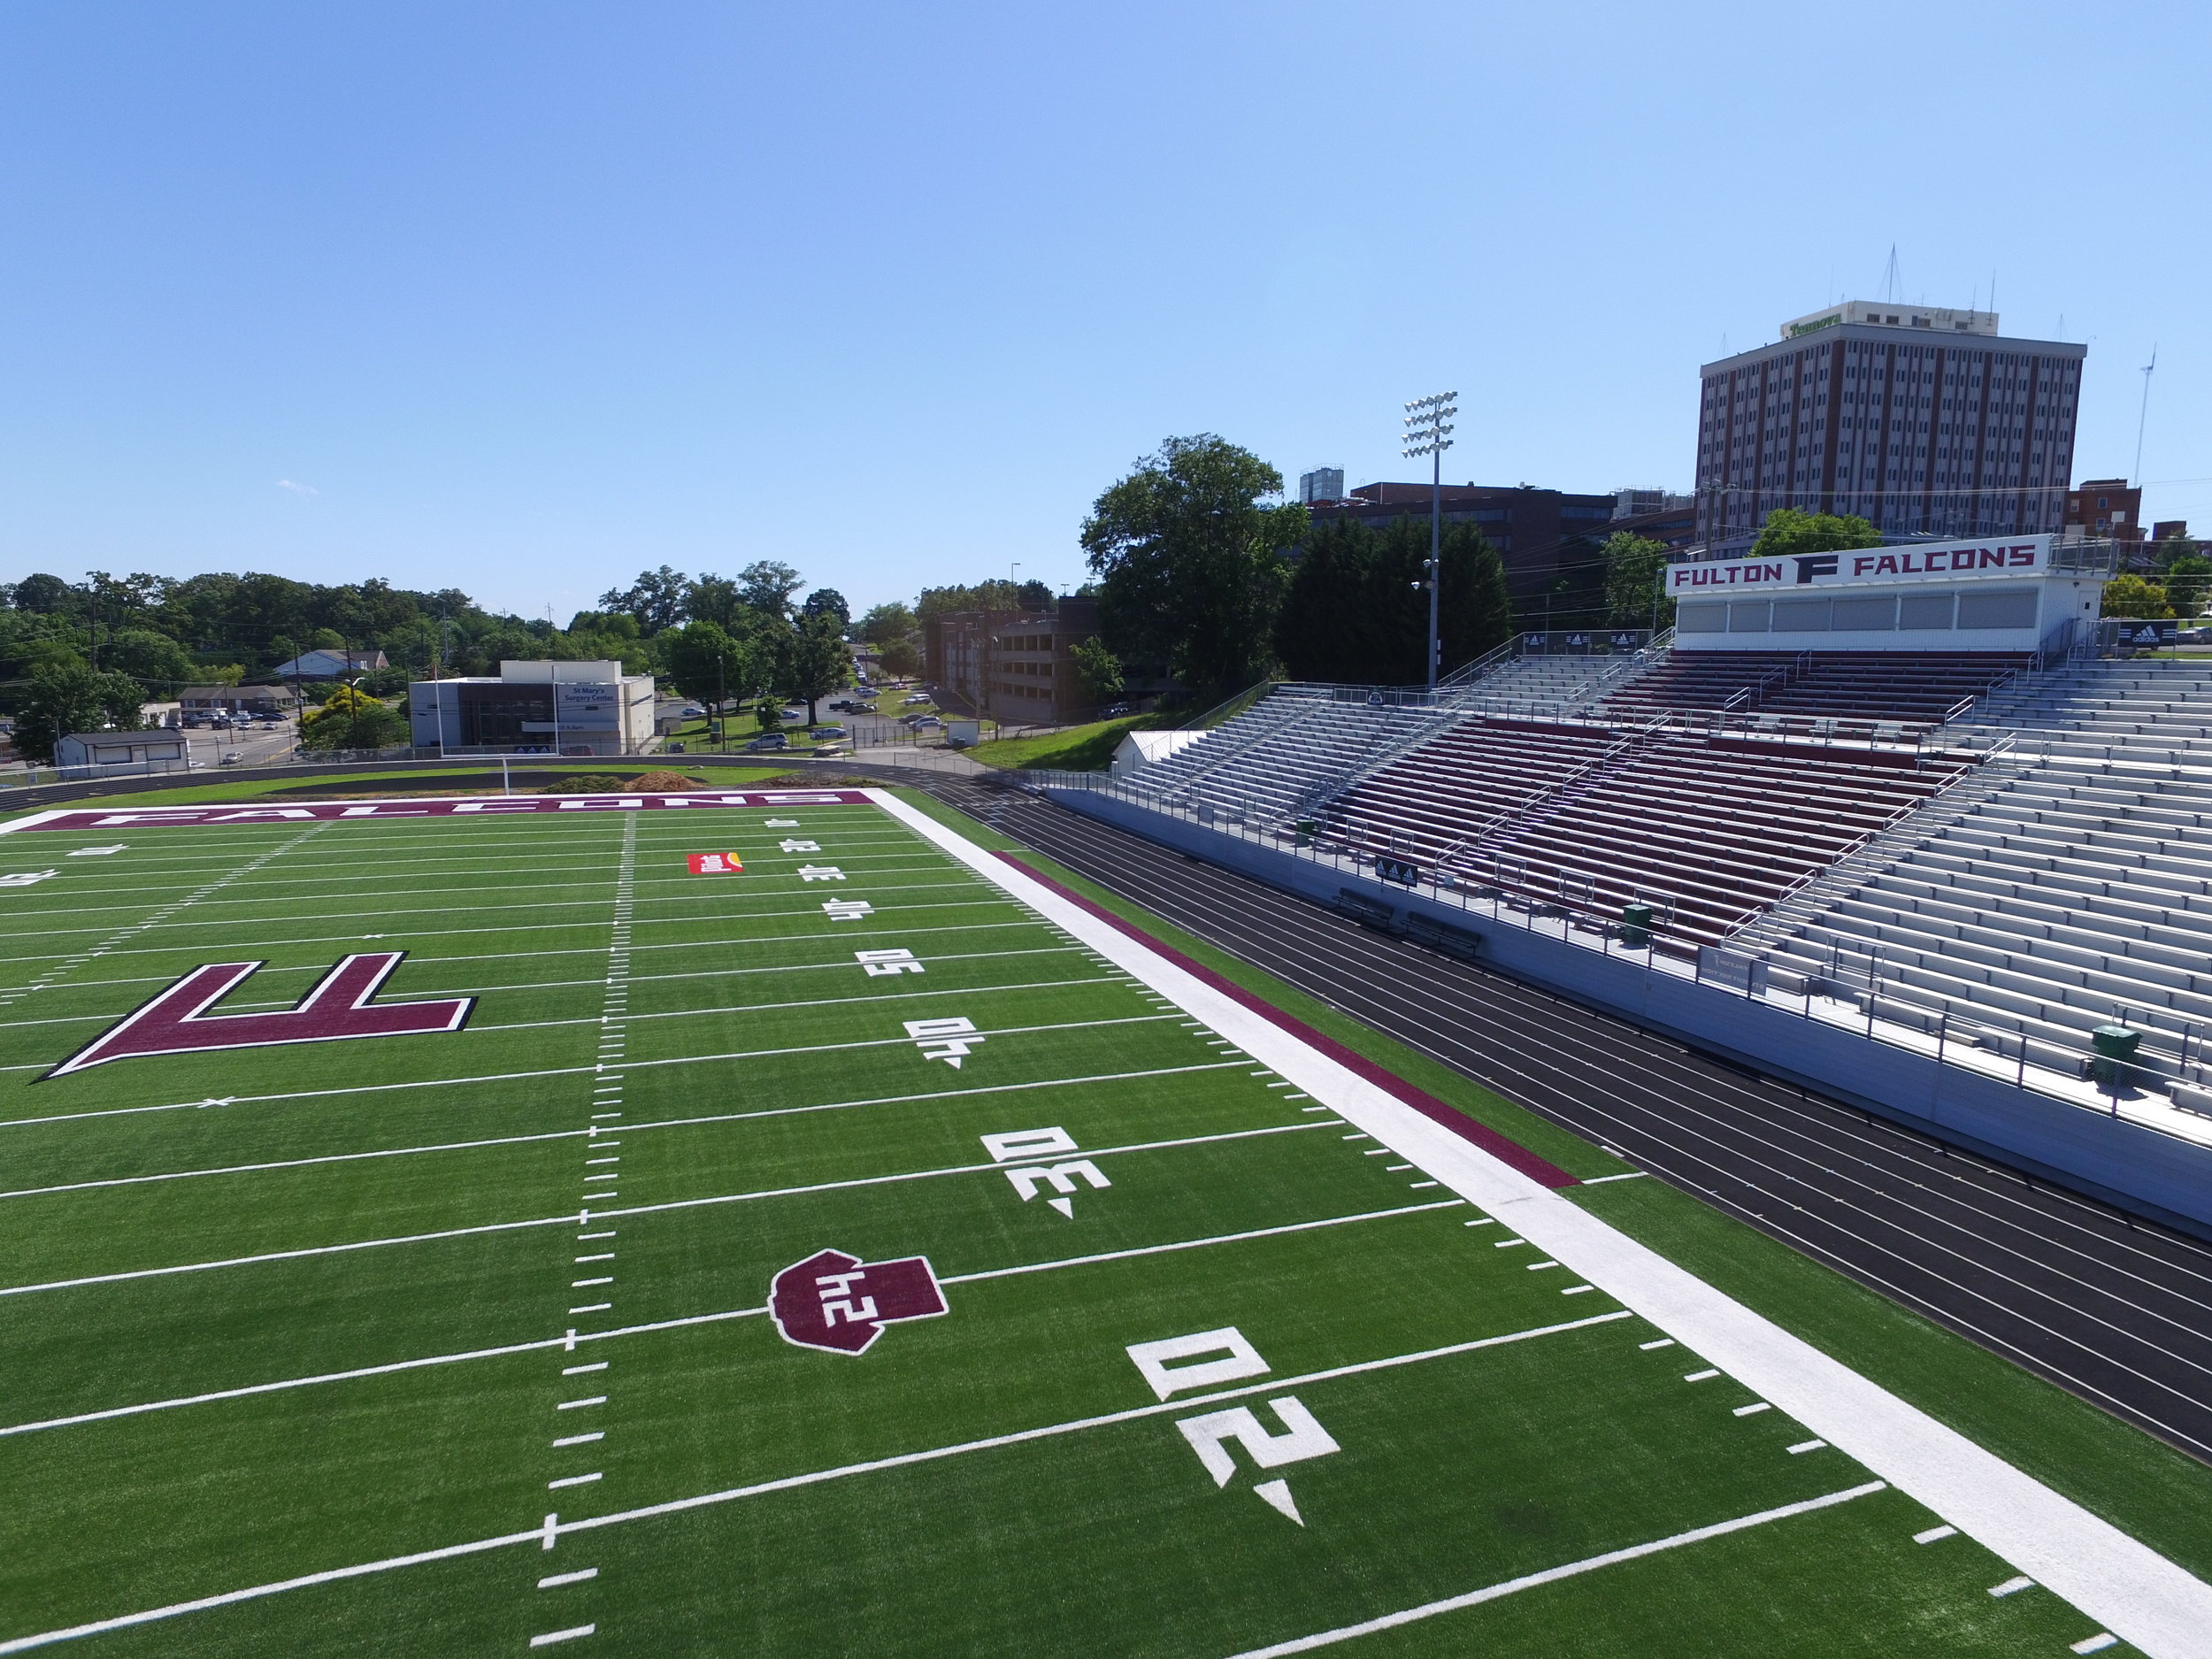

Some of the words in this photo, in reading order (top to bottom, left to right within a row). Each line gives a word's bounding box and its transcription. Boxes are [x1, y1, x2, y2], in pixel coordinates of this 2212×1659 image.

[1675, 564, 1782, 587] FULTON
[1792, 555, 1839, 584] F
[1854, 545, 2036, 576] FALCONS
[89, 793, 843, 826] FALCONS
[854, 949, 926, 977] 50
[27, 950, 480, 1086] F
[902, 1017, 986, 1061] 40
[979, 1126, 1111, 1202] 30
[1125, 1326, 1341, 1488] 20
